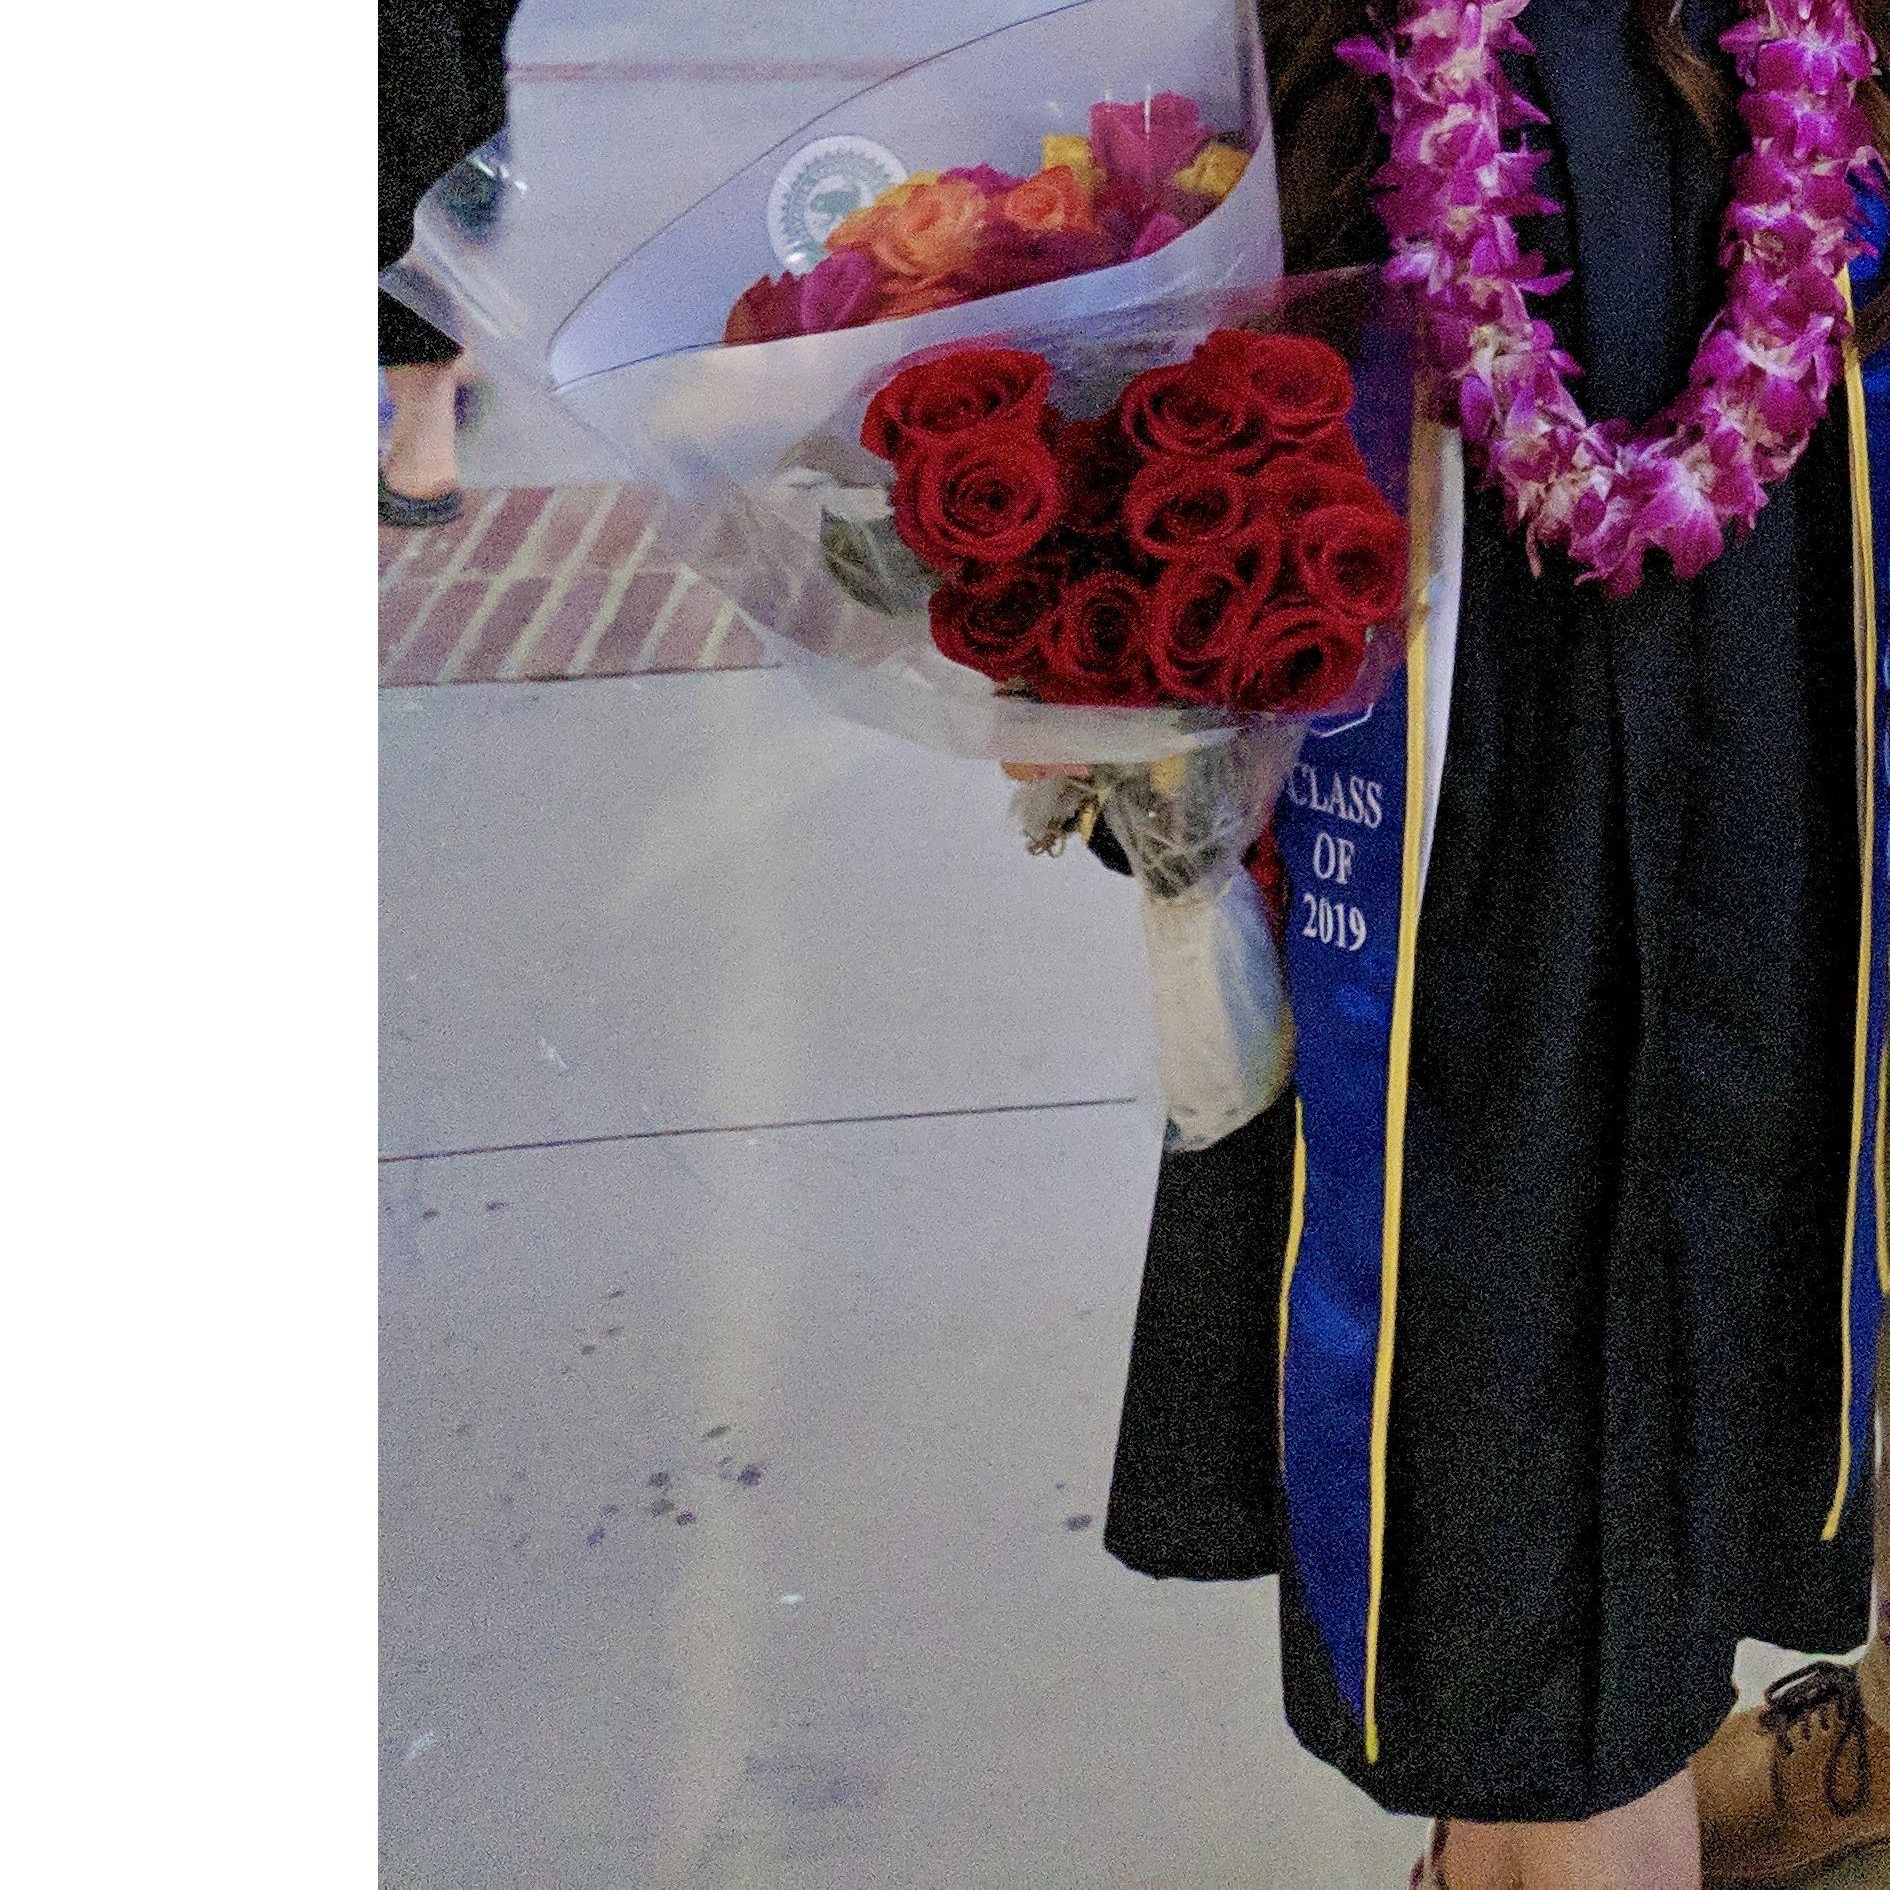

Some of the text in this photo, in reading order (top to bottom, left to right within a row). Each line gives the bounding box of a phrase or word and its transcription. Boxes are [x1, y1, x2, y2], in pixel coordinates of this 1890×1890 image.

[1288, 763, 1382, 829] CLASS
[1313, 831, 1354, 885] OF
[1303, 893, 1367, 952] 2019
